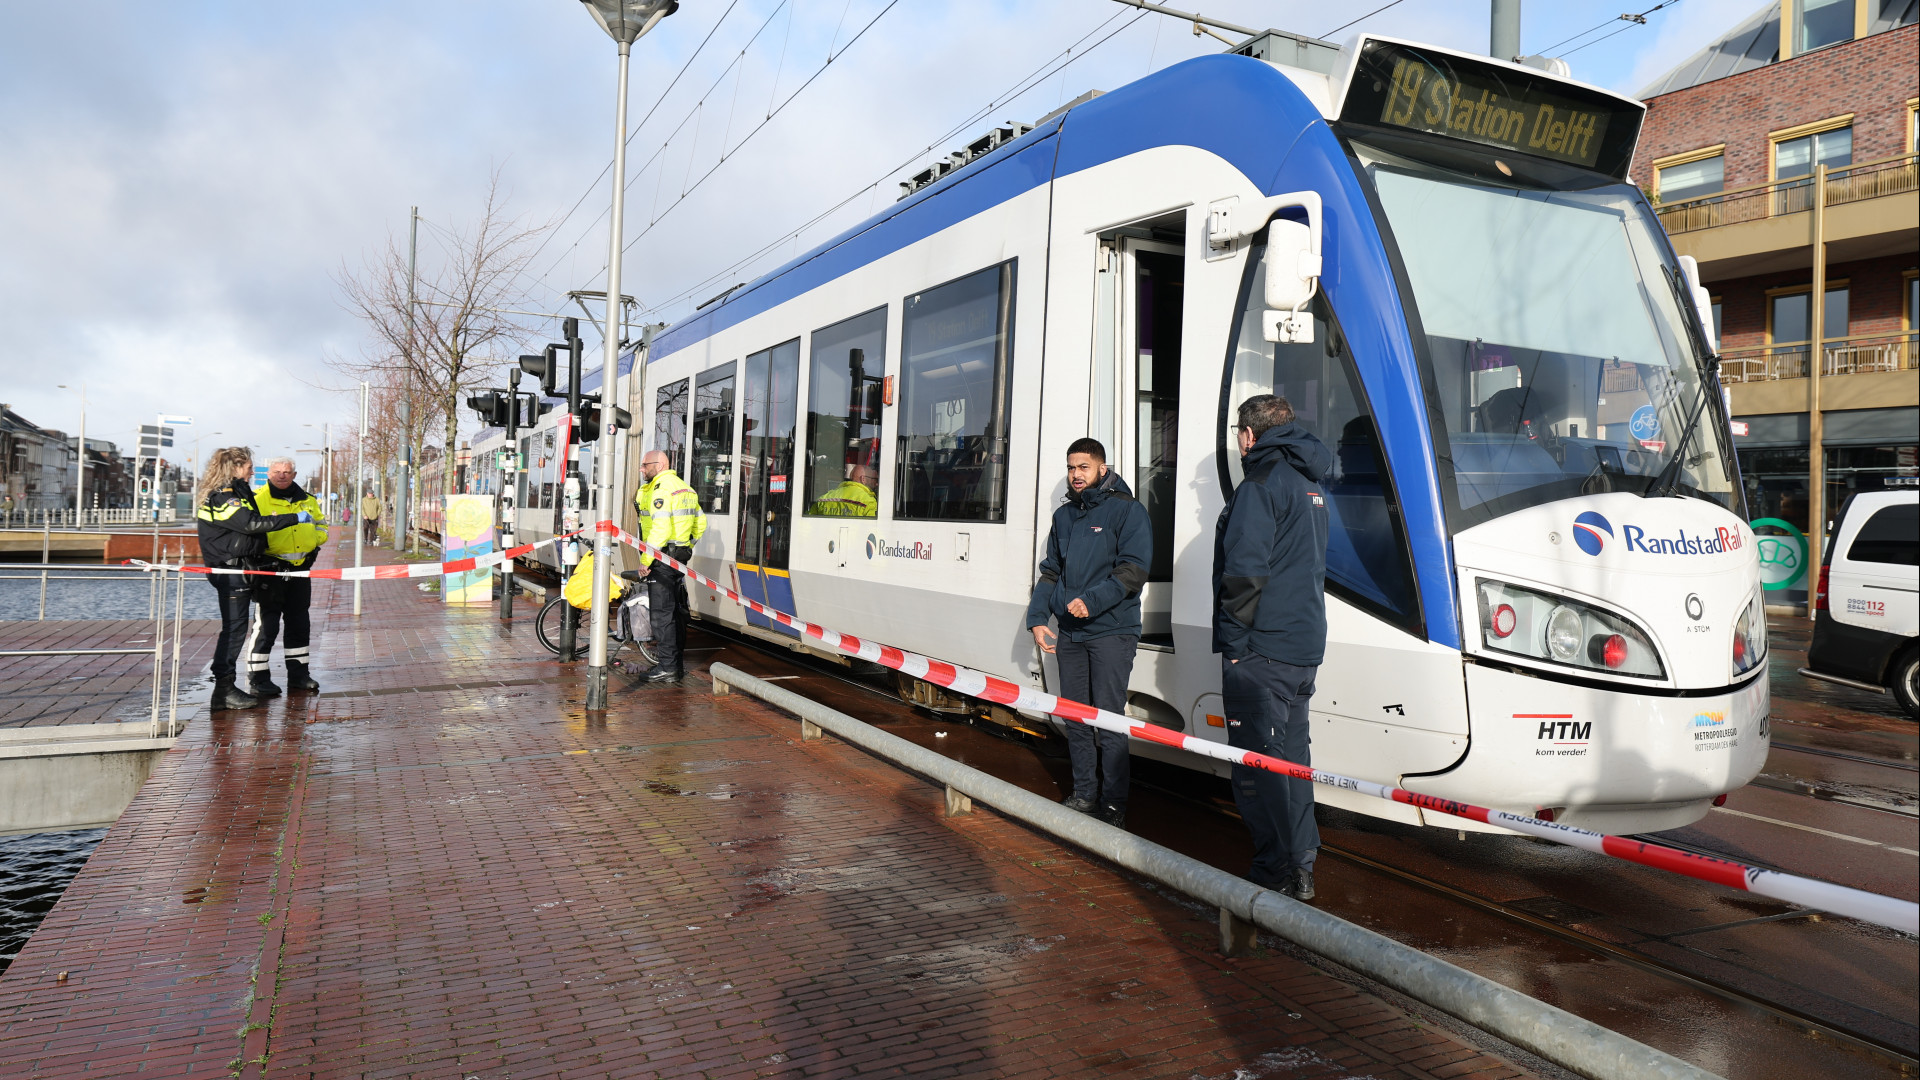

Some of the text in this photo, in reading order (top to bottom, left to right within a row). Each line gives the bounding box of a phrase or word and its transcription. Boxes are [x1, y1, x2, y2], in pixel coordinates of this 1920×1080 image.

[1384, 58, 1598, 158] 19 Station Delft
[1312, 496, 1324, 505] HTM
[1623, 523, 1742, 555] RandstadRail
[879, 539, 932, 560] RandstadRail
[1866, 600, 1885, 610] 112
[1538, 721, 1592, 739] HTM
[1535, 748, 1587, 756] kom verder!
[1289, 768, 1358, 790] NIET BETREDEN
